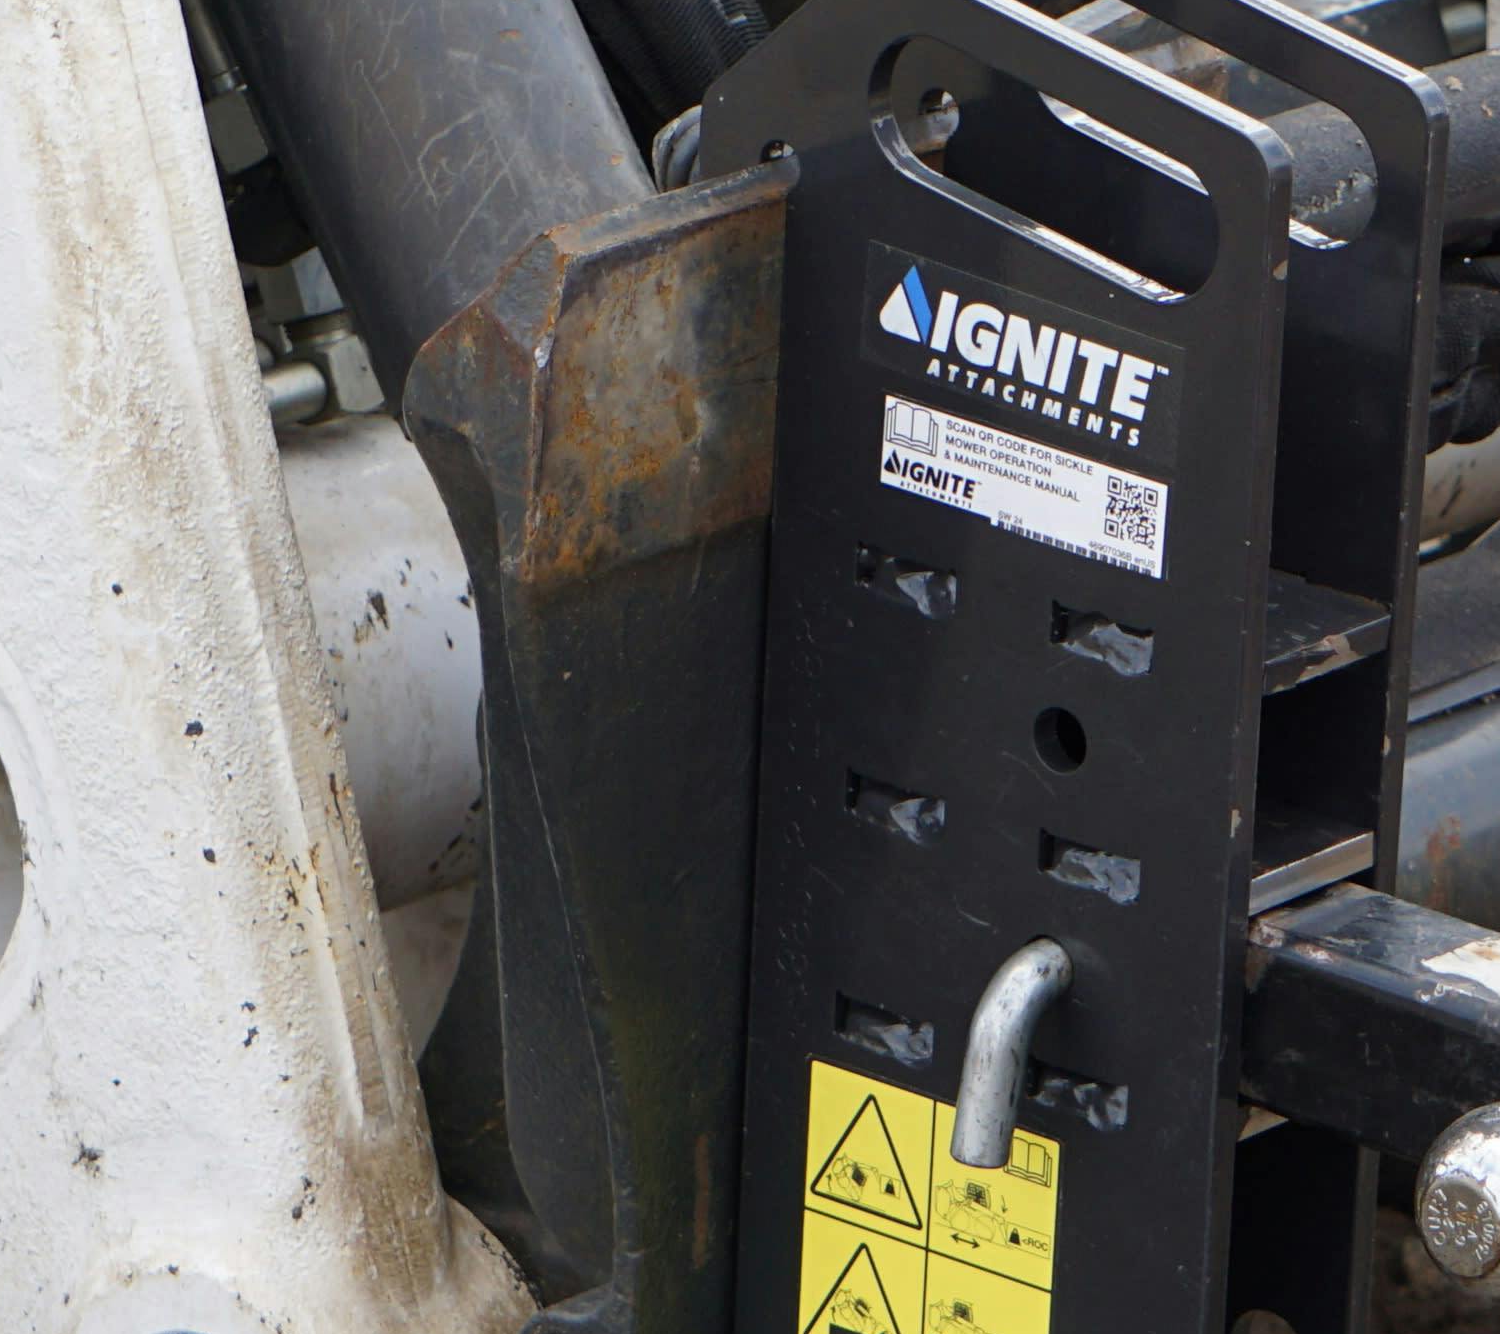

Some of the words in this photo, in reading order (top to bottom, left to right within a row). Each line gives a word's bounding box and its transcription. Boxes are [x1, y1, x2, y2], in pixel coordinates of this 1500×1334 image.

[926, 358, 1141, 447] ATTACHMENTS
[945, 434, 987, 457] MOWER
[989, 449, 1052, 478] OPERATION
[946, 419, 976, 438] SCAN
[978, 430, 994, 443] QR
[996, 436, 1027, 455] CODE
[1030, 446, 1052, 463] FOR
[1055, 454, 1094, 476] SICKLE
[954, 453, 1032, 487] MAINTENANCE
[1034, 479, 1080, 502] MANUAL
